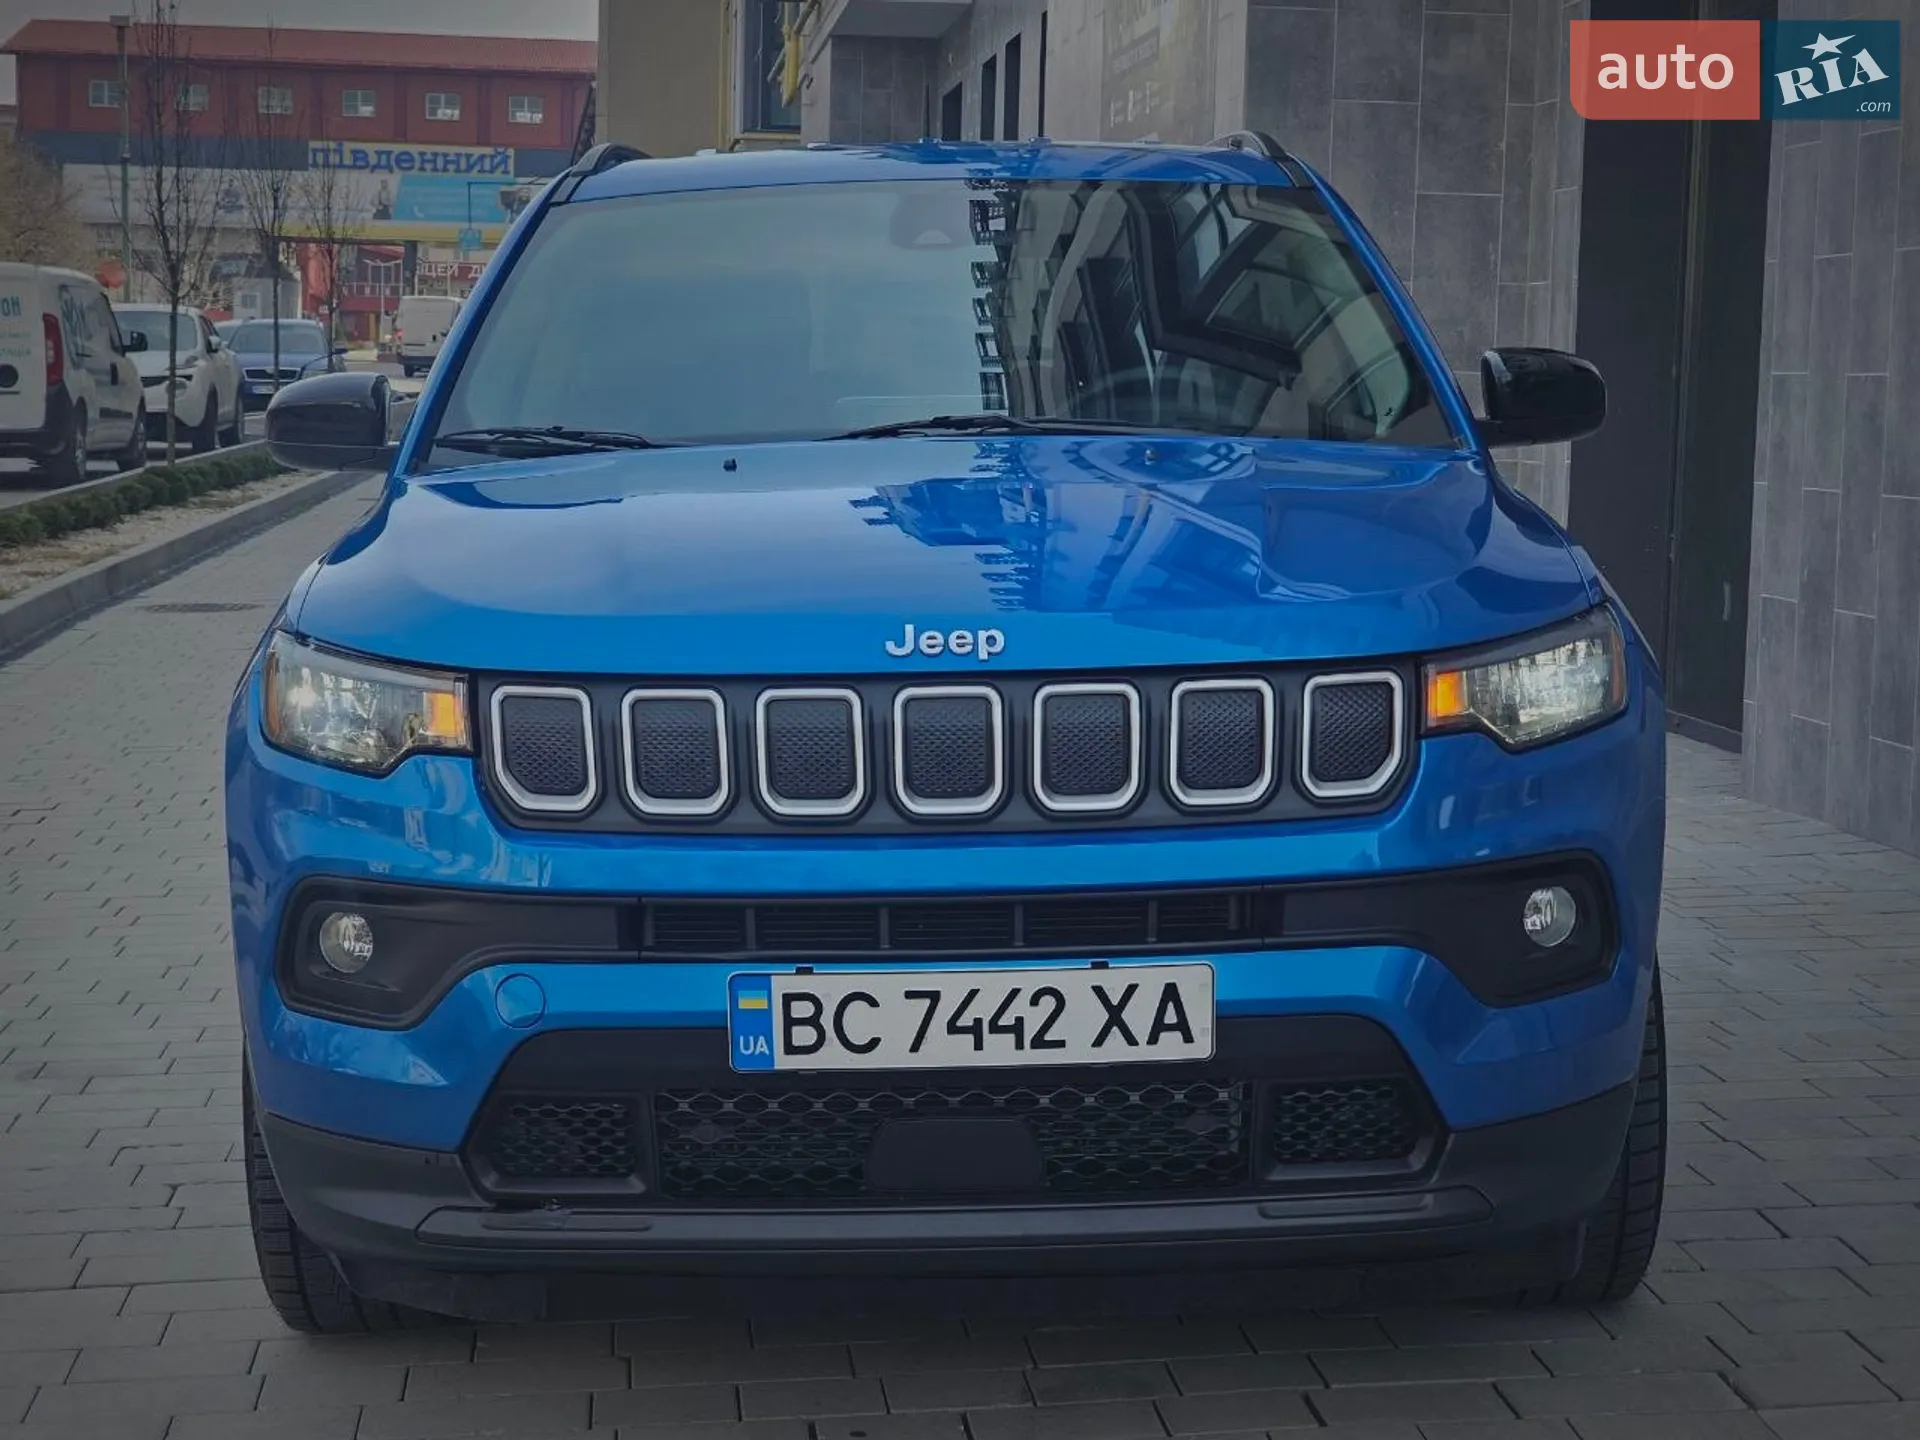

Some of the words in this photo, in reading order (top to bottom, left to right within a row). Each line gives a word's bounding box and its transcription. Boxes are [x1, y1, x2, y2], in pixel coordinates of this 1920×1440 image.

[885, 623, 1005, 660] Jeep
[739, 1035, 770, 1056] UA
[781, 991, 882, 1056] BC
[903, 986, 1067, 1053] 7442
[1090, 982, 1196, 1048] XA
